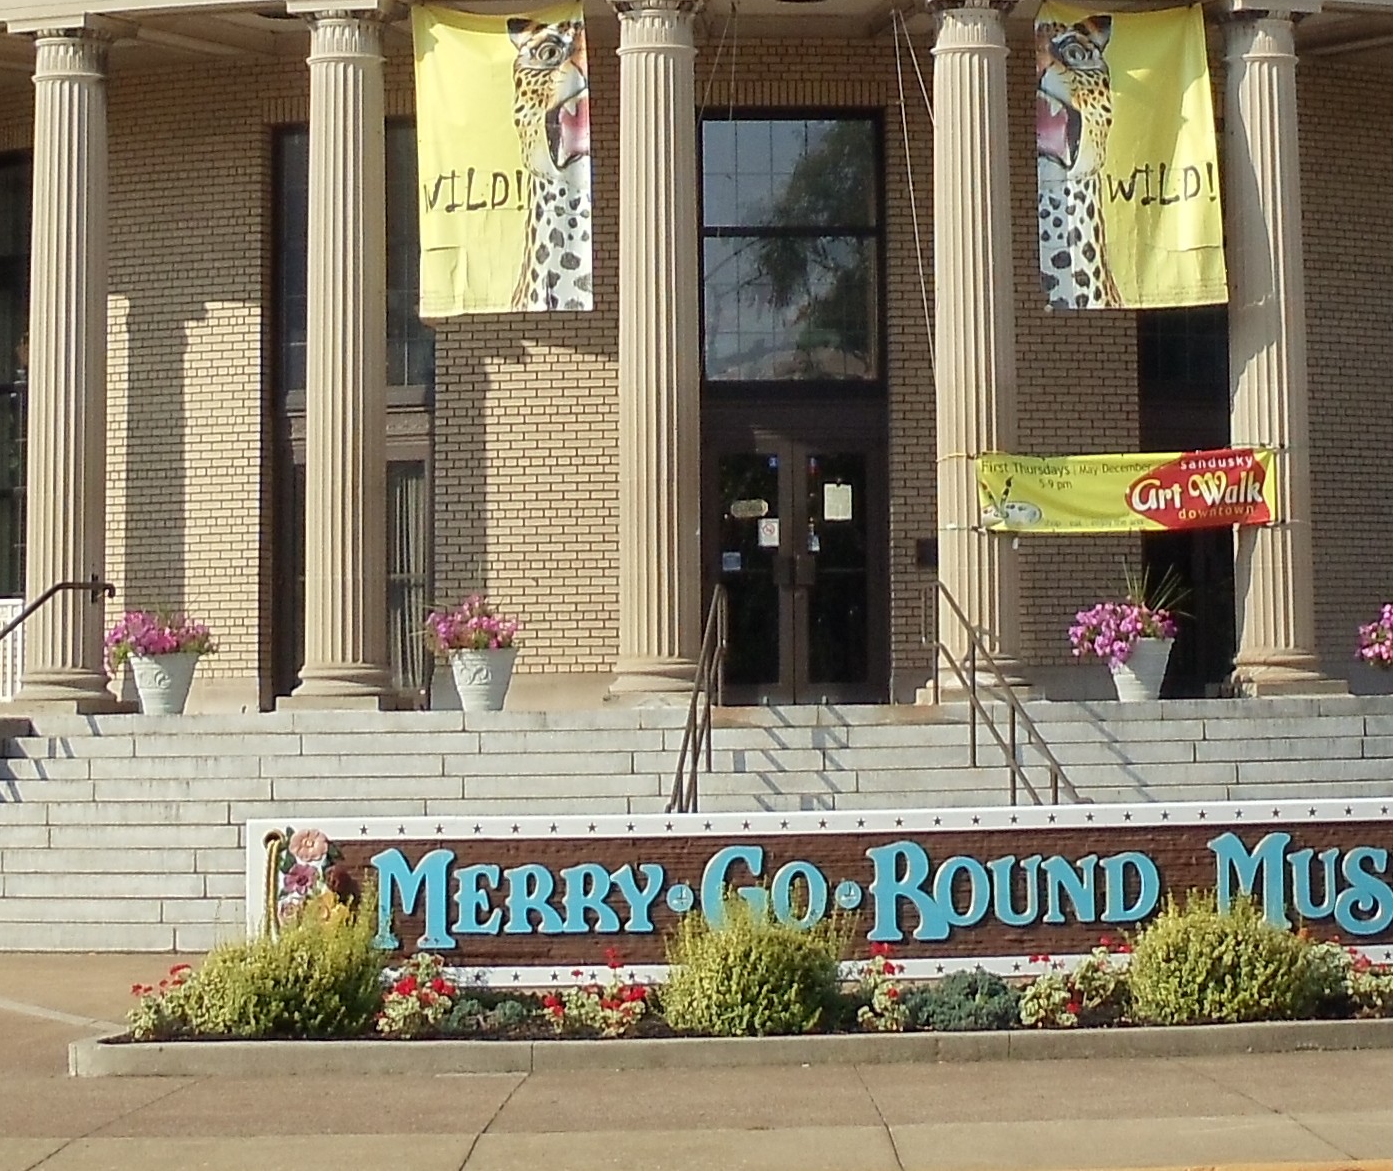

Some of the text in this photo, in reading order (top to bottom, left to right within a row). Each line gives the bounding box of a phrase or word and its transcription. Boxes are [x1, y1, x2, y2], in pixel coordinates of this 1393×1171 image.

[1106, 162, 1217, 206] WILD!
[981, 461, 1009, 474] First
[1014, 461, 1071, 478] Thursdays
[1102, 462, 1152, 475] December
[1180, 455, 1254, 470] sandusky
[1188, 470, 1264, 507] Walk
[1178, 505, 1255, 520] downtown
